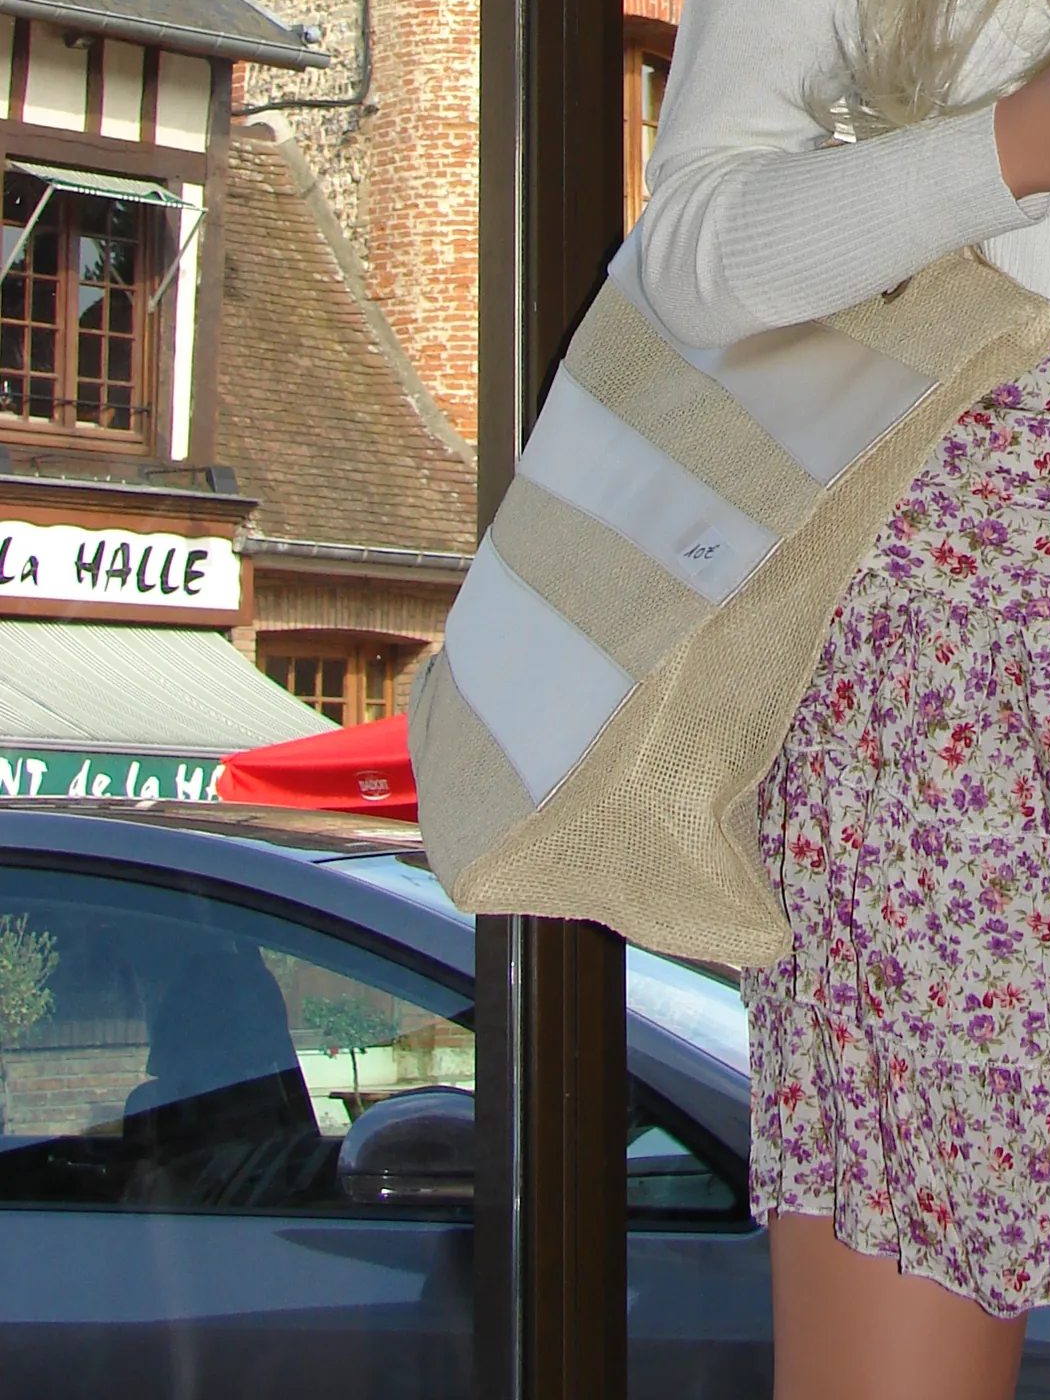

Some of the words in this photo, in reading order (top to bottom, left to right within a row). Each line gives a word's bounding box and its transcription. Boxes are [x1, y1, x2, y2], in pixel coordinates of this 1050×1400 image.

[0, 537, 39, 586] La
[75, 540, 208, 595] HALLE
[68, 758, 112, 799] de
[125, 760, 160, 800] la
